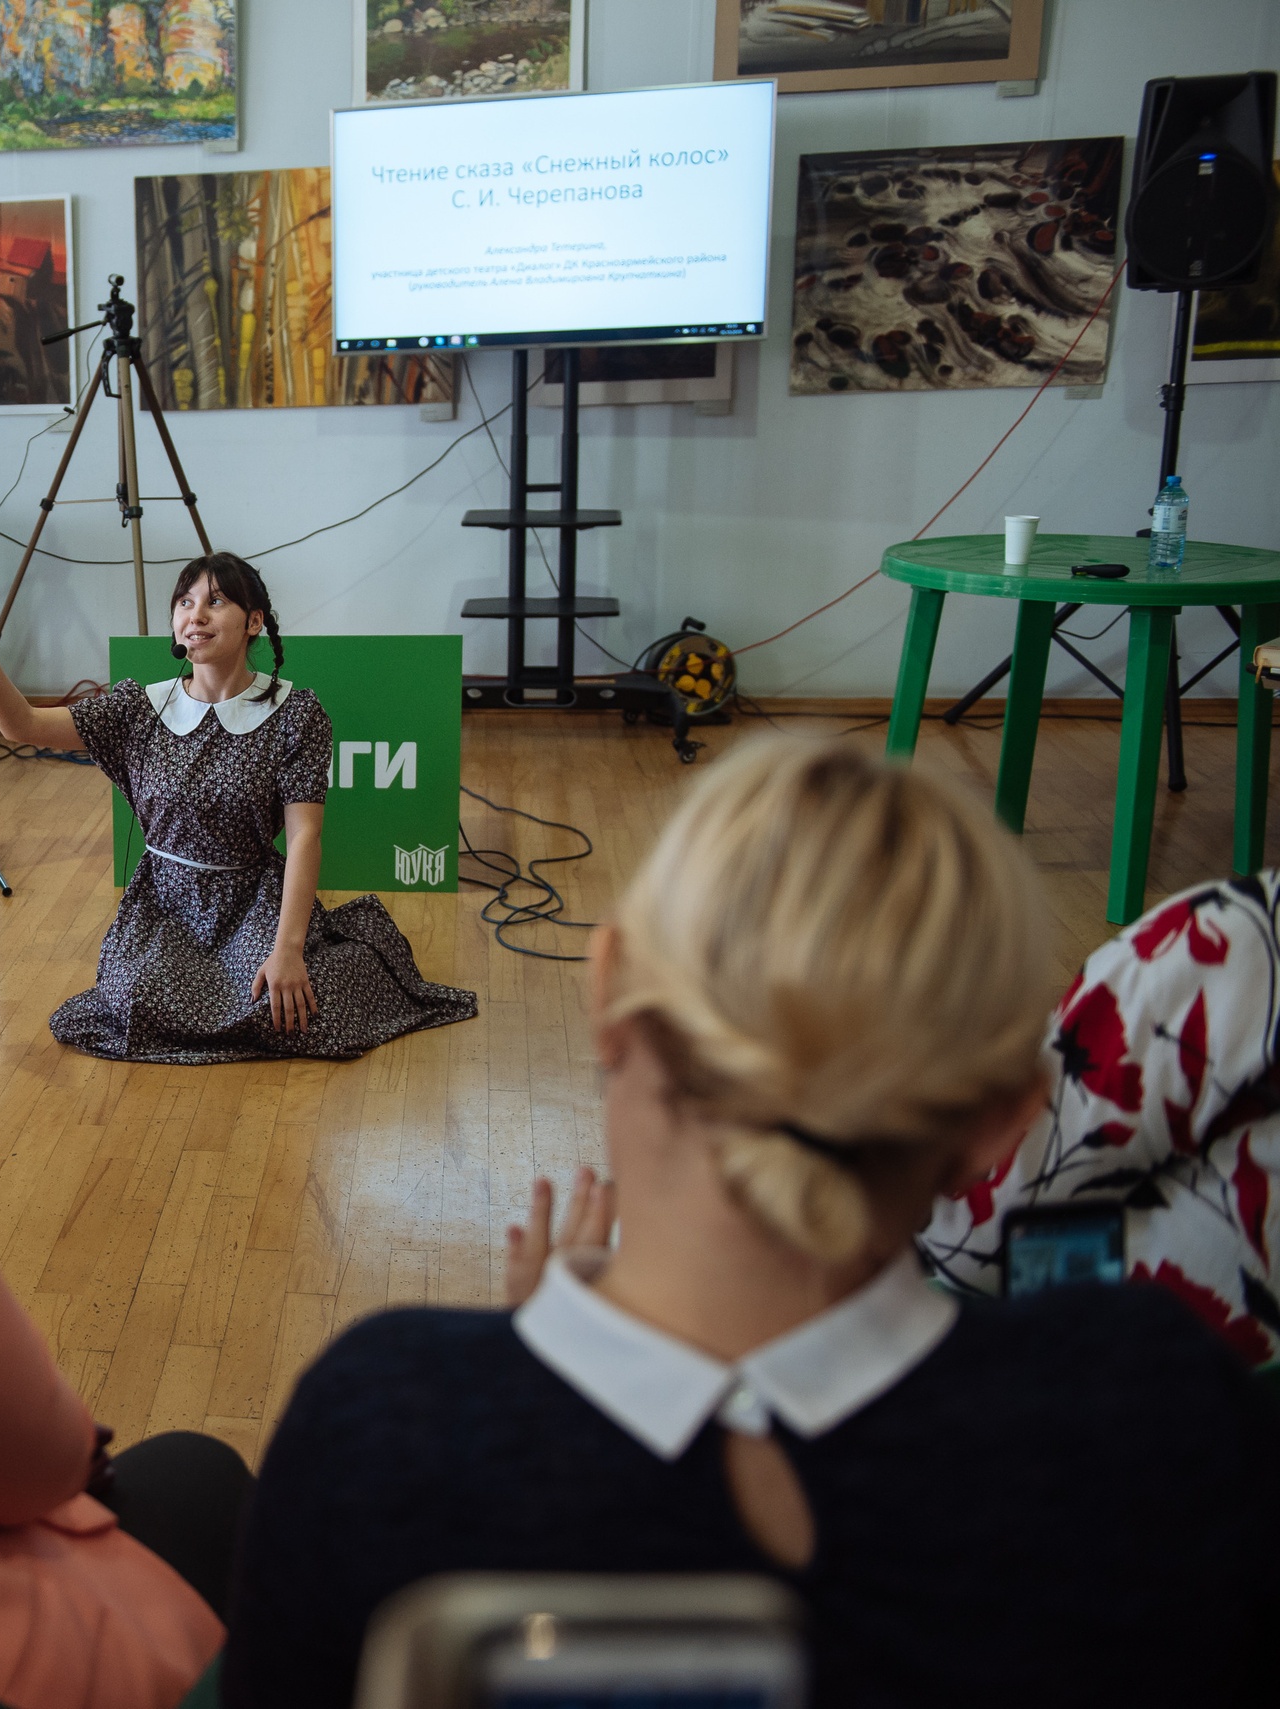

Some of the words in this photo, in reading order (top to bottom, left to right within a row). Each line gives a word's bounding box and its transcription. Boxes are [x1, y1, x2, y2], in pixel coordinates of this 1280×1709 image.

[371, 164, 449, 183] Чтение
[455, 161, 514, 179] сказа
[522, 148, 641, 175] «Снежный
[649, 148, 729, 168] колос»
[451, 190, 470, 209] С.
[479, 188, 500, 208] И.
[508, 183, 643, 208] Черепанова
[686, 252, 727, 265] района
